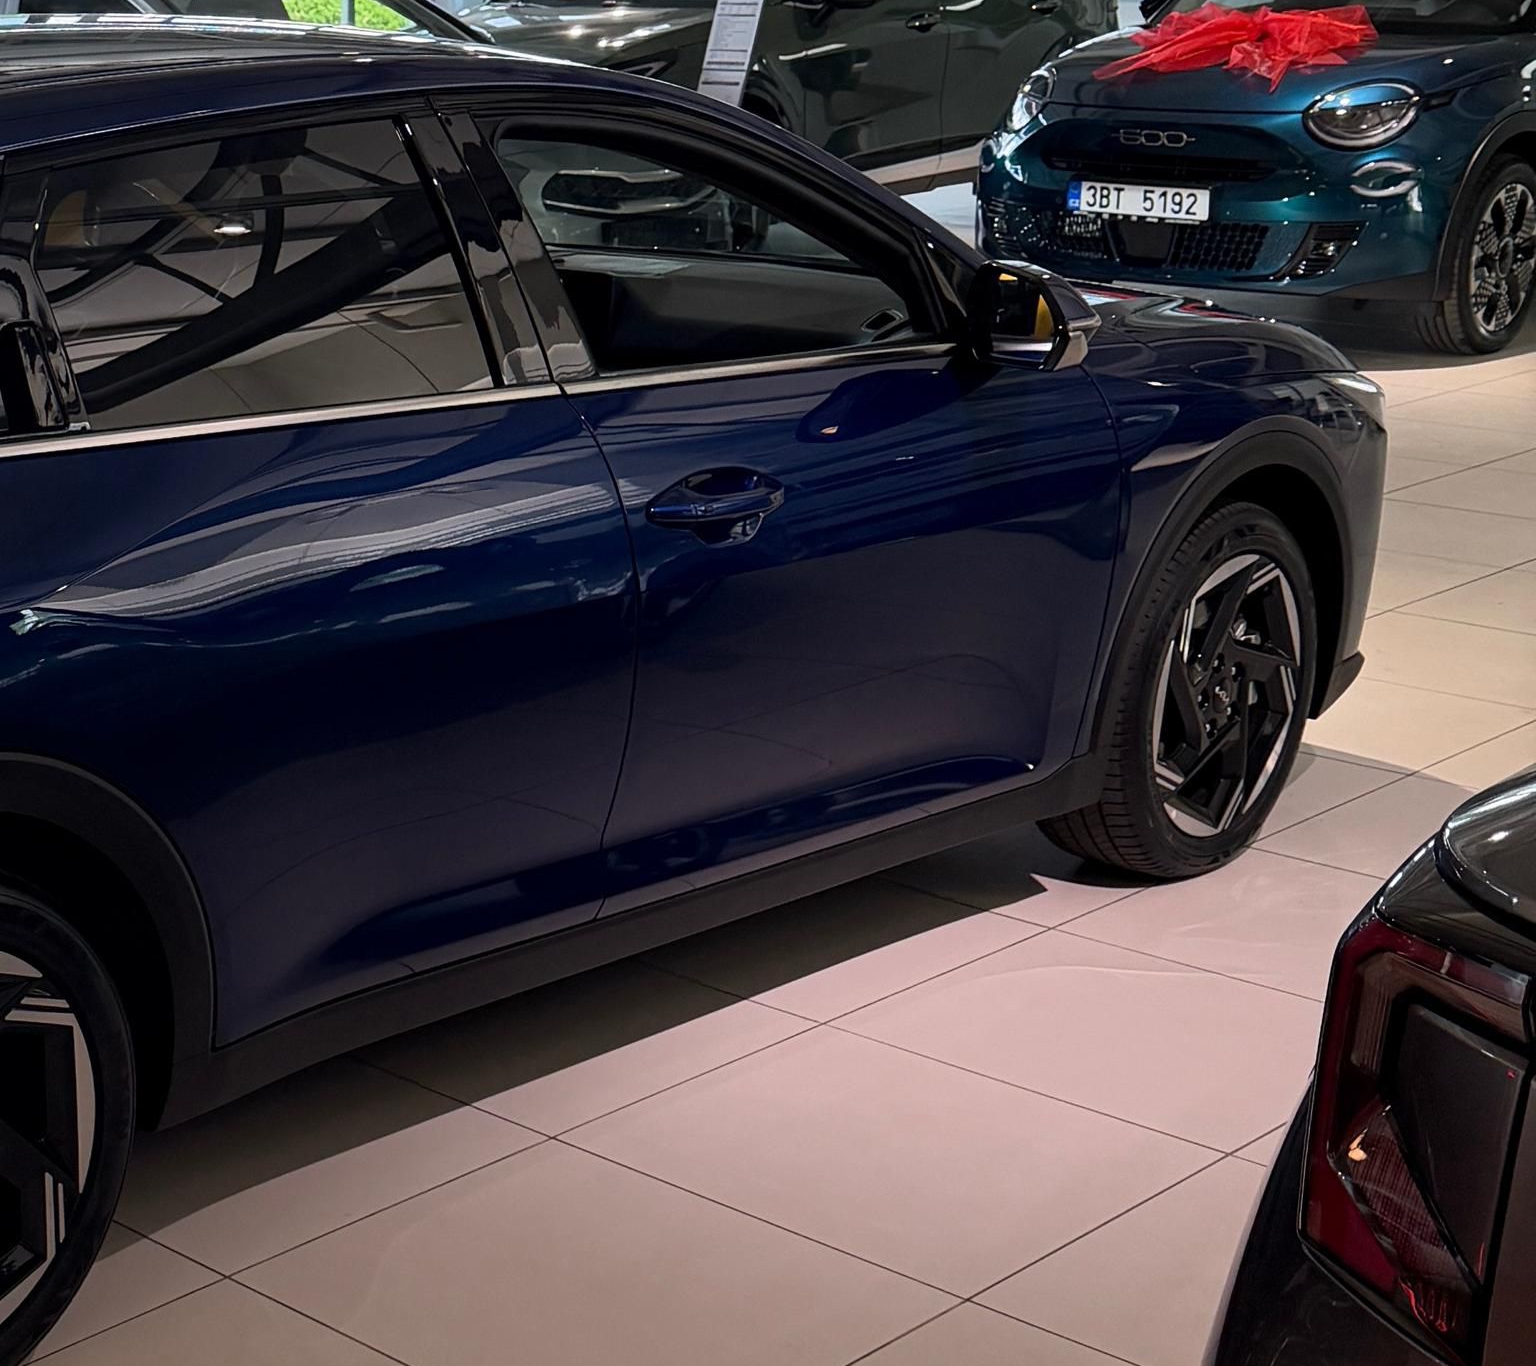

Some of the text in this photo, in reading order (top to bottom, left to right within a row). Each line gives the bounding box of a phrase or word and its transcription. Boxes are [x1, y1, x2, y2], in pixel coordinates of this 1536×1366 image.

[1119, 129, 1187, 147] 500
[1086, 185, 1198, 216] 3BT 5192
